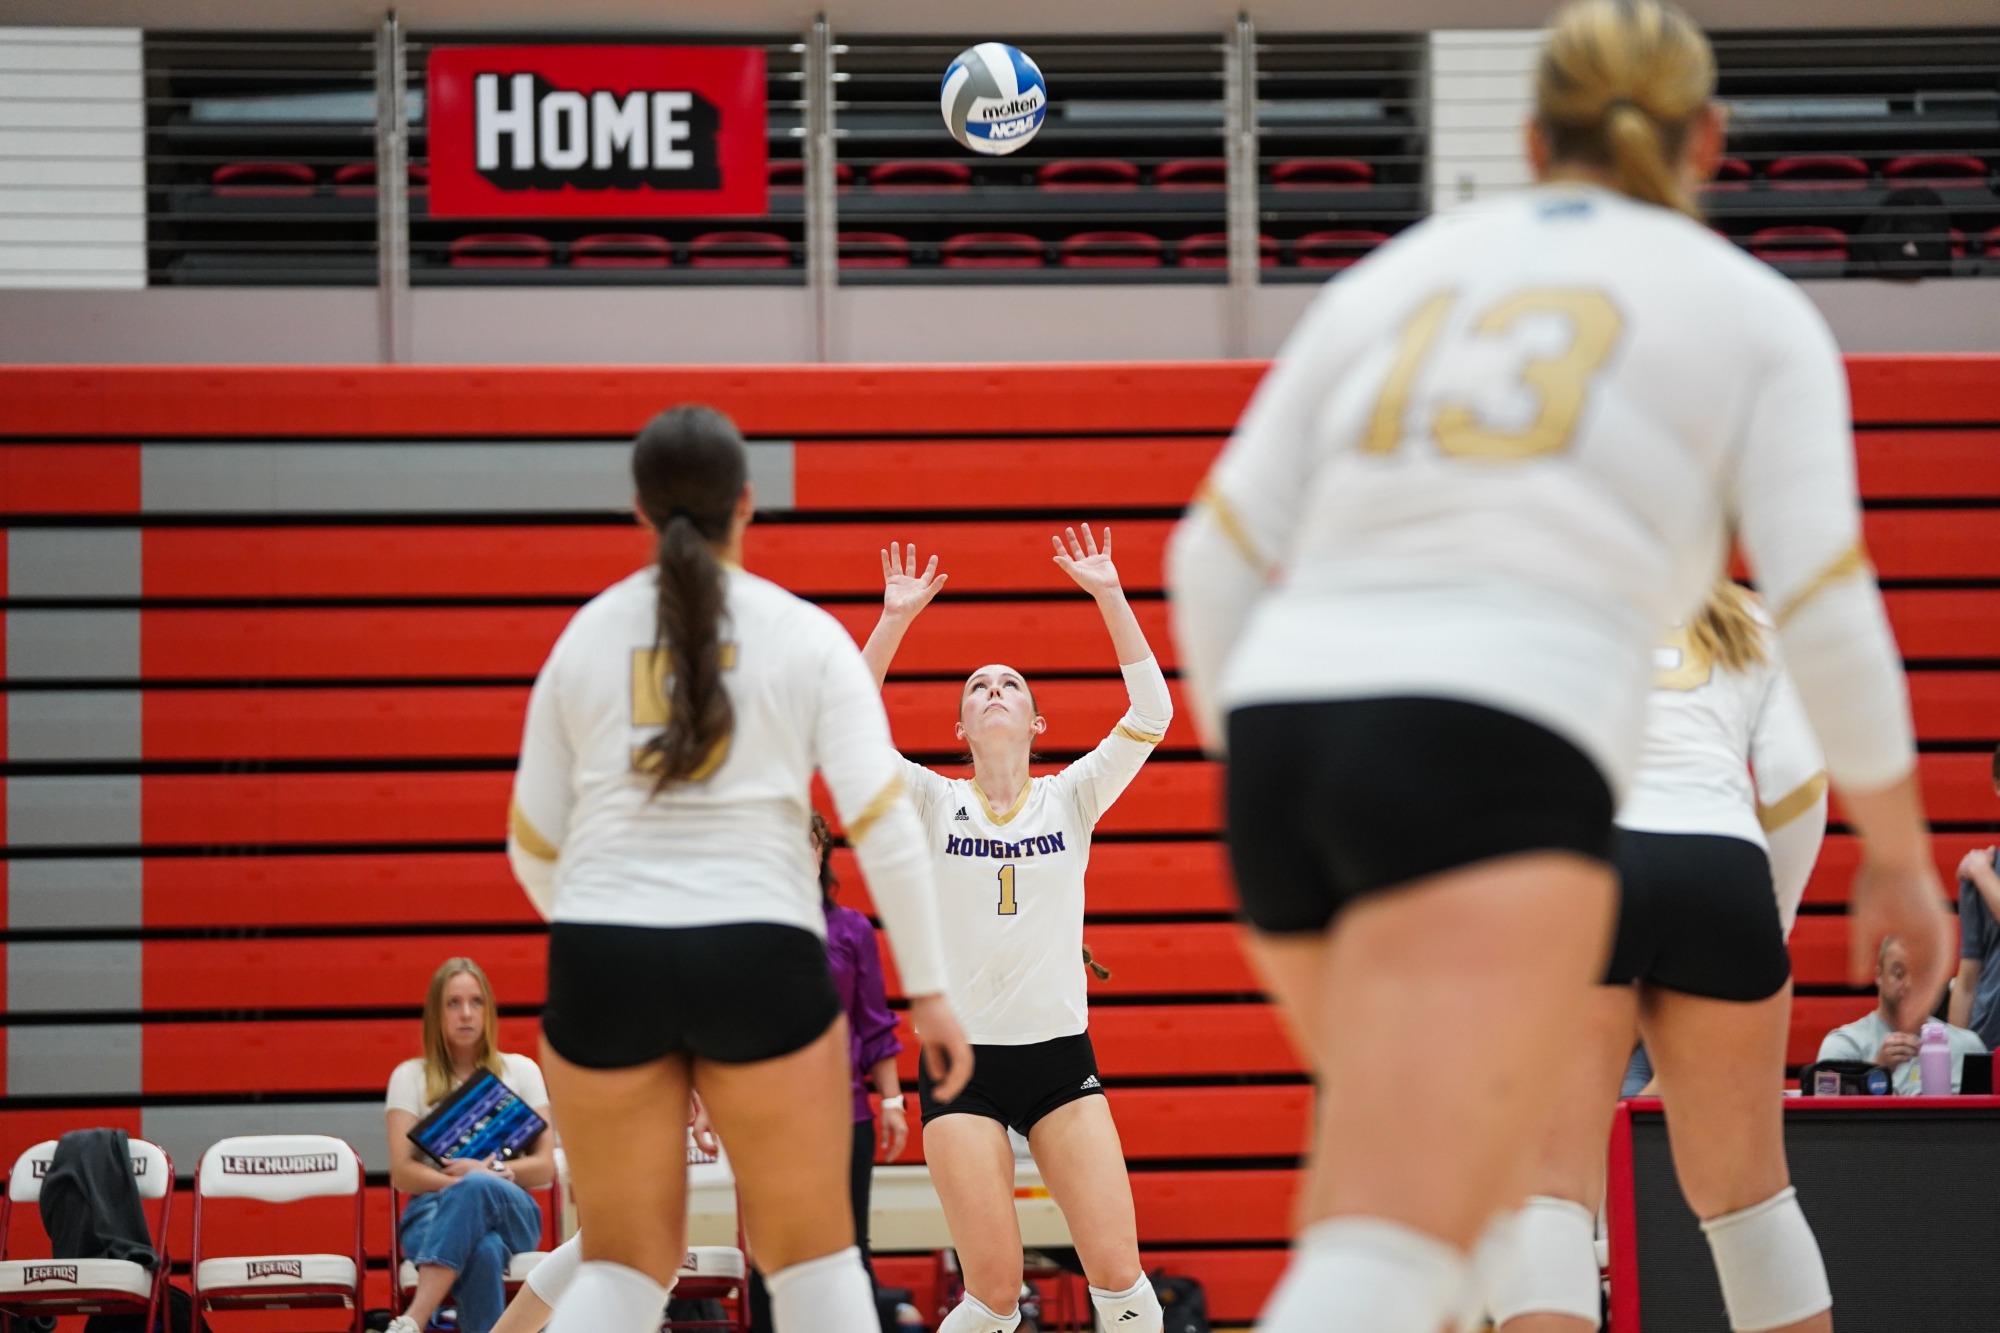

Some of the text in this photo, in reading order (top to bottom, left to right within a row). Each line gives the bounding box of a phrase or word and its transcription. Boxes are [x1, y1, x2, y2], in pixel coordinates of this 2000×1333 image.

[982, 97, 1038, 121] molten
[989, 115, 1035, 139] NCAA
[1355, 286, 1625, 459] 13
[946, 831, 1066, 859] HOUGHTON
[998, 864, 1017, 915] 1
[221, 1153, 338, 1174] LETCHWORTH
[23, 1264, 78, 1286] LEGENDS
[246, 1260, 303, 1281] LEGENDS
